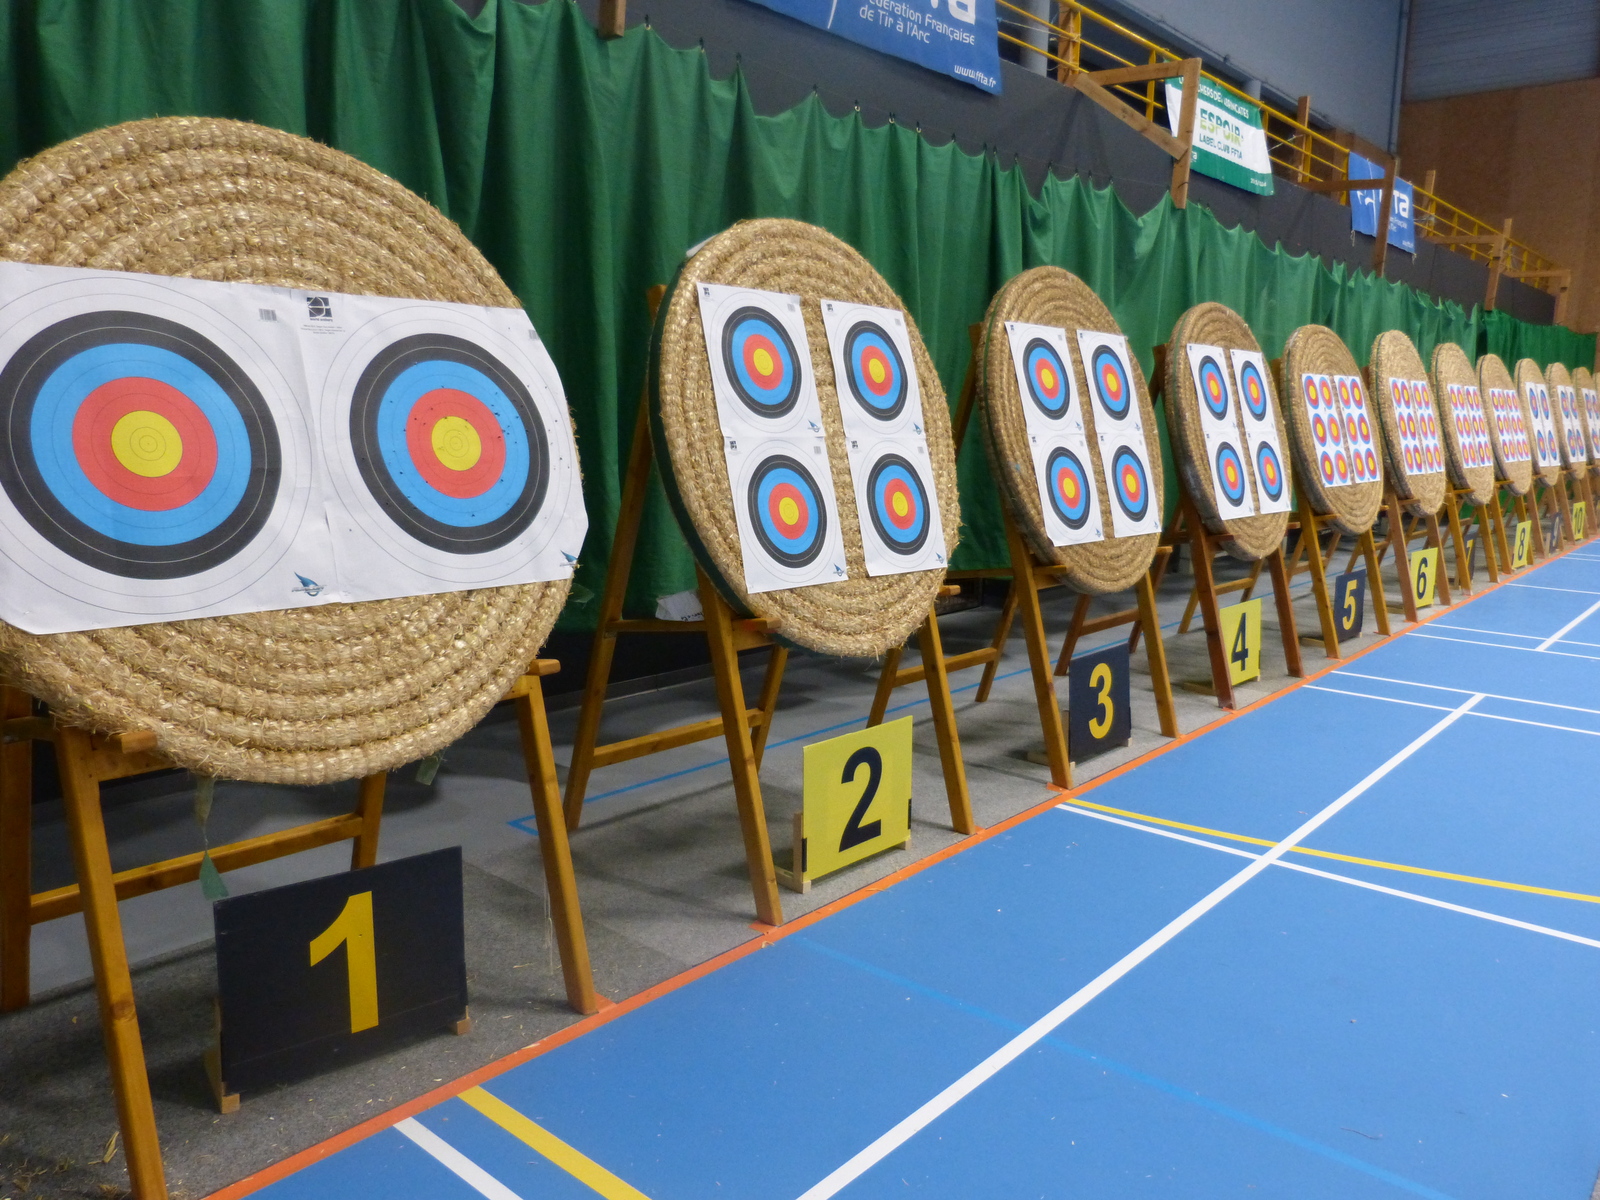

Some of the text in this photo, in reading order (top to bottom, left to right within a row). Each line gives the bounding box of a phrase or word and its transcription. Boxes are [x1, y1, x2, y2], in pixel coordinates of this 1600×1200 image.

[859, 5, 931, 44] de Tir à l'Arc
[925, 14, 976, 46] Française
[1199, 133, 1217, 149] LABEL
[1217, 142, 1231, 155] CLUB
[1200, 108, 1242, 147] ESPOIR
[1518, 527, 1525, 561] 8
[1416, 557, 1428, 600] 6
[1342, 579, 1357, 630] 5
[1231, 612, 1249, 671] 4
[1089, 663, 1114, 739] 3
[838, 746, 883, 852] 2
[309, 890, 379, 1034] 1
